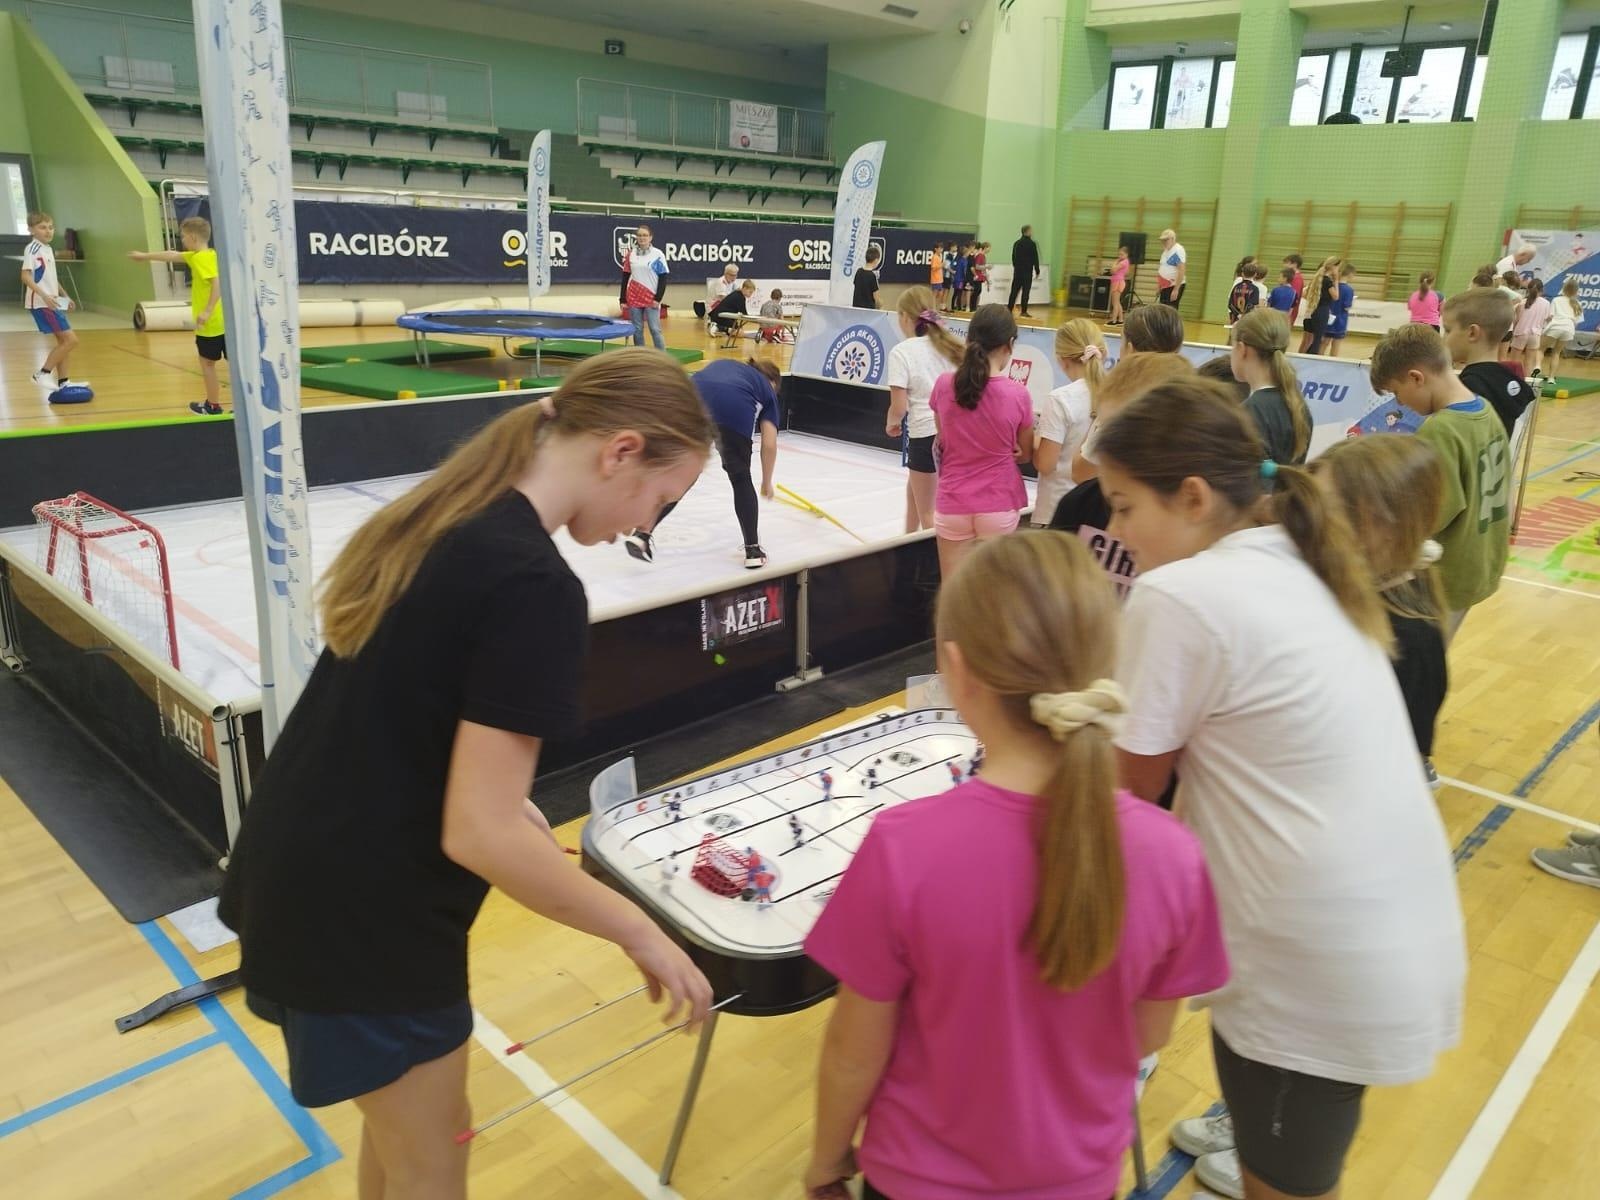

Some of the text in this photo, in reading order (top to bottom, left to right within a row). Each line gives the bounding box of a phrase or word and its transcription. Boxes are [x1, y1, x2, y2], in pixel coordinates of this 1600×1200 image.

[309, 228, 449, 257] RACIBÓRZ
[665, 239, 753, 262] RACIBÓRZ
[843, 217, 860, 277] CURLING
